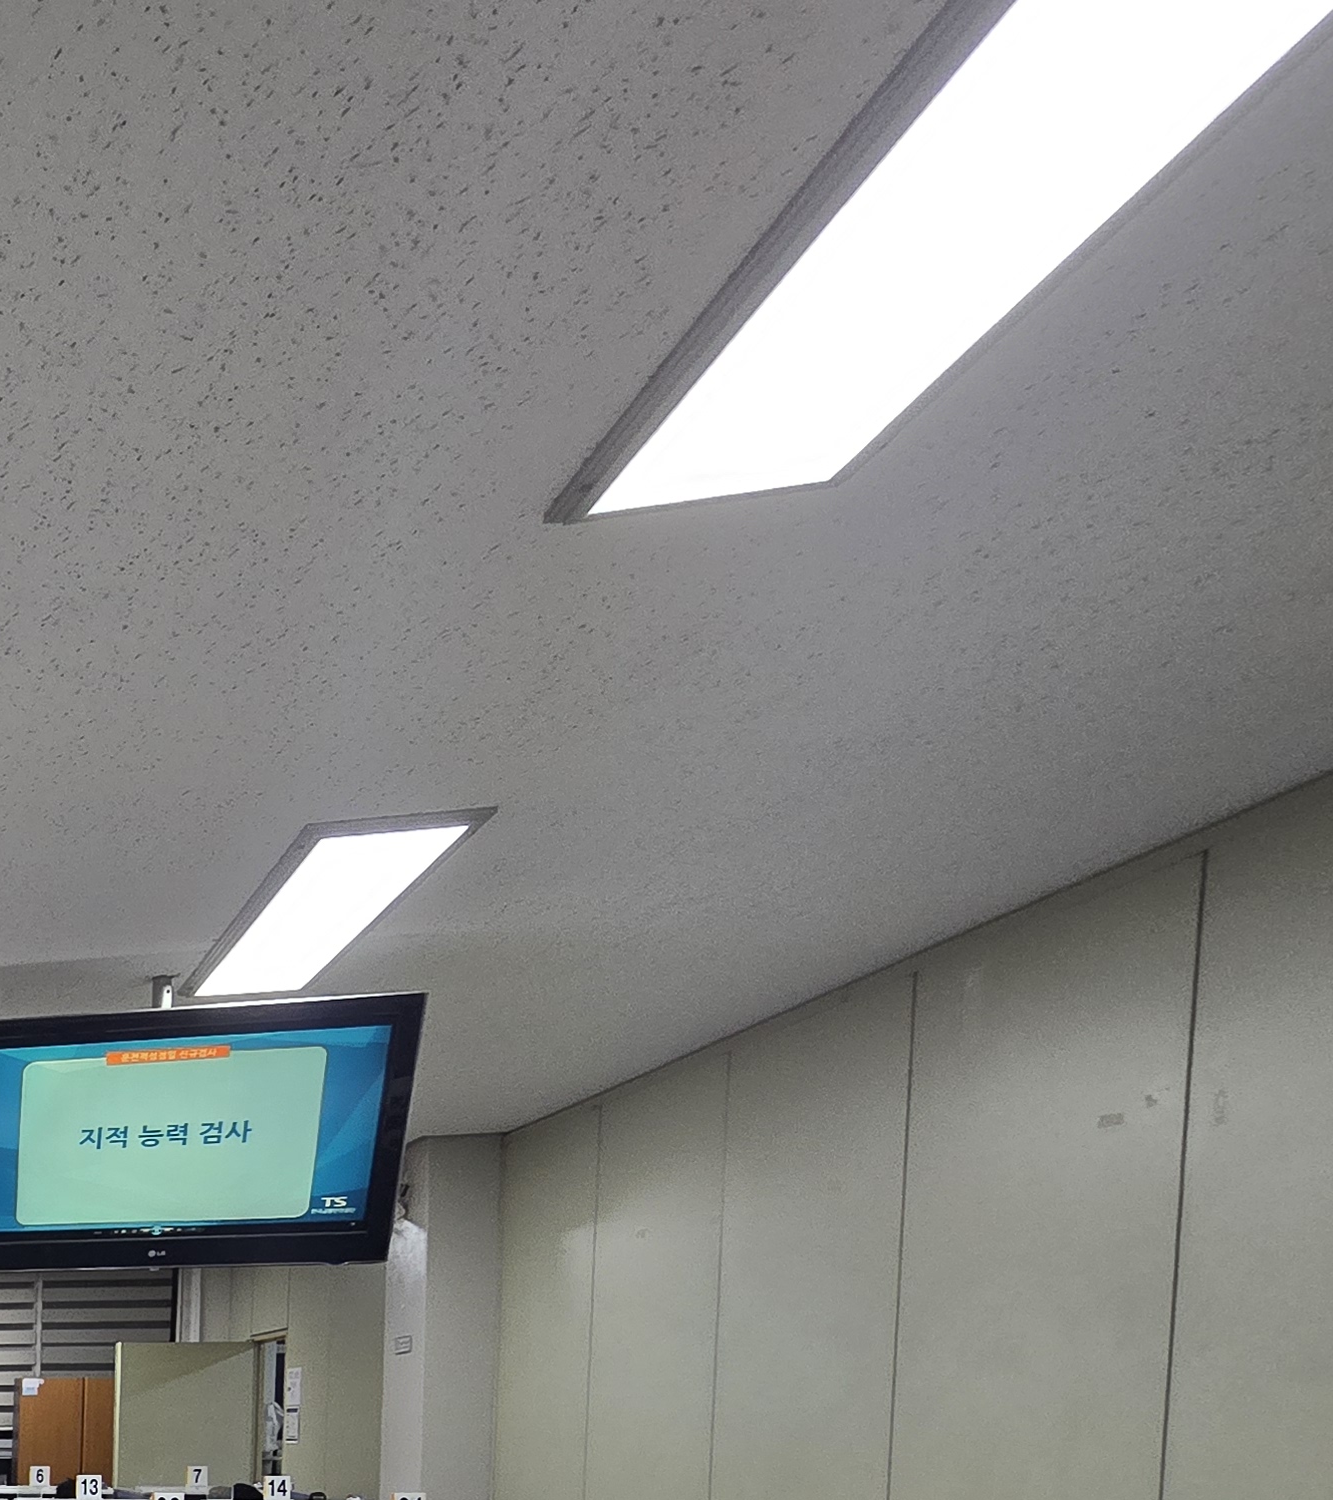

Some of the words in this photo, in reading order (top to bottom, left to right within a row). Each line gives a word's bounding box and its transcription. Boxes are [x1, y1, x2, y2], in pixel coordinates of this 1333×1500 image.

[79, 1126, 129, 1149] 지적
[138, 1123, 189, 1147] 능력
[200, 1120, 252, 1144] 검사
[321, 1196, 347, 1207] TS
[37, 1469, 43, 1483] 6
[193, 1469, 201, 1483] 7
[82, 1479, 98, 1495] 13
[269, 1480, 287, 1496] 14
